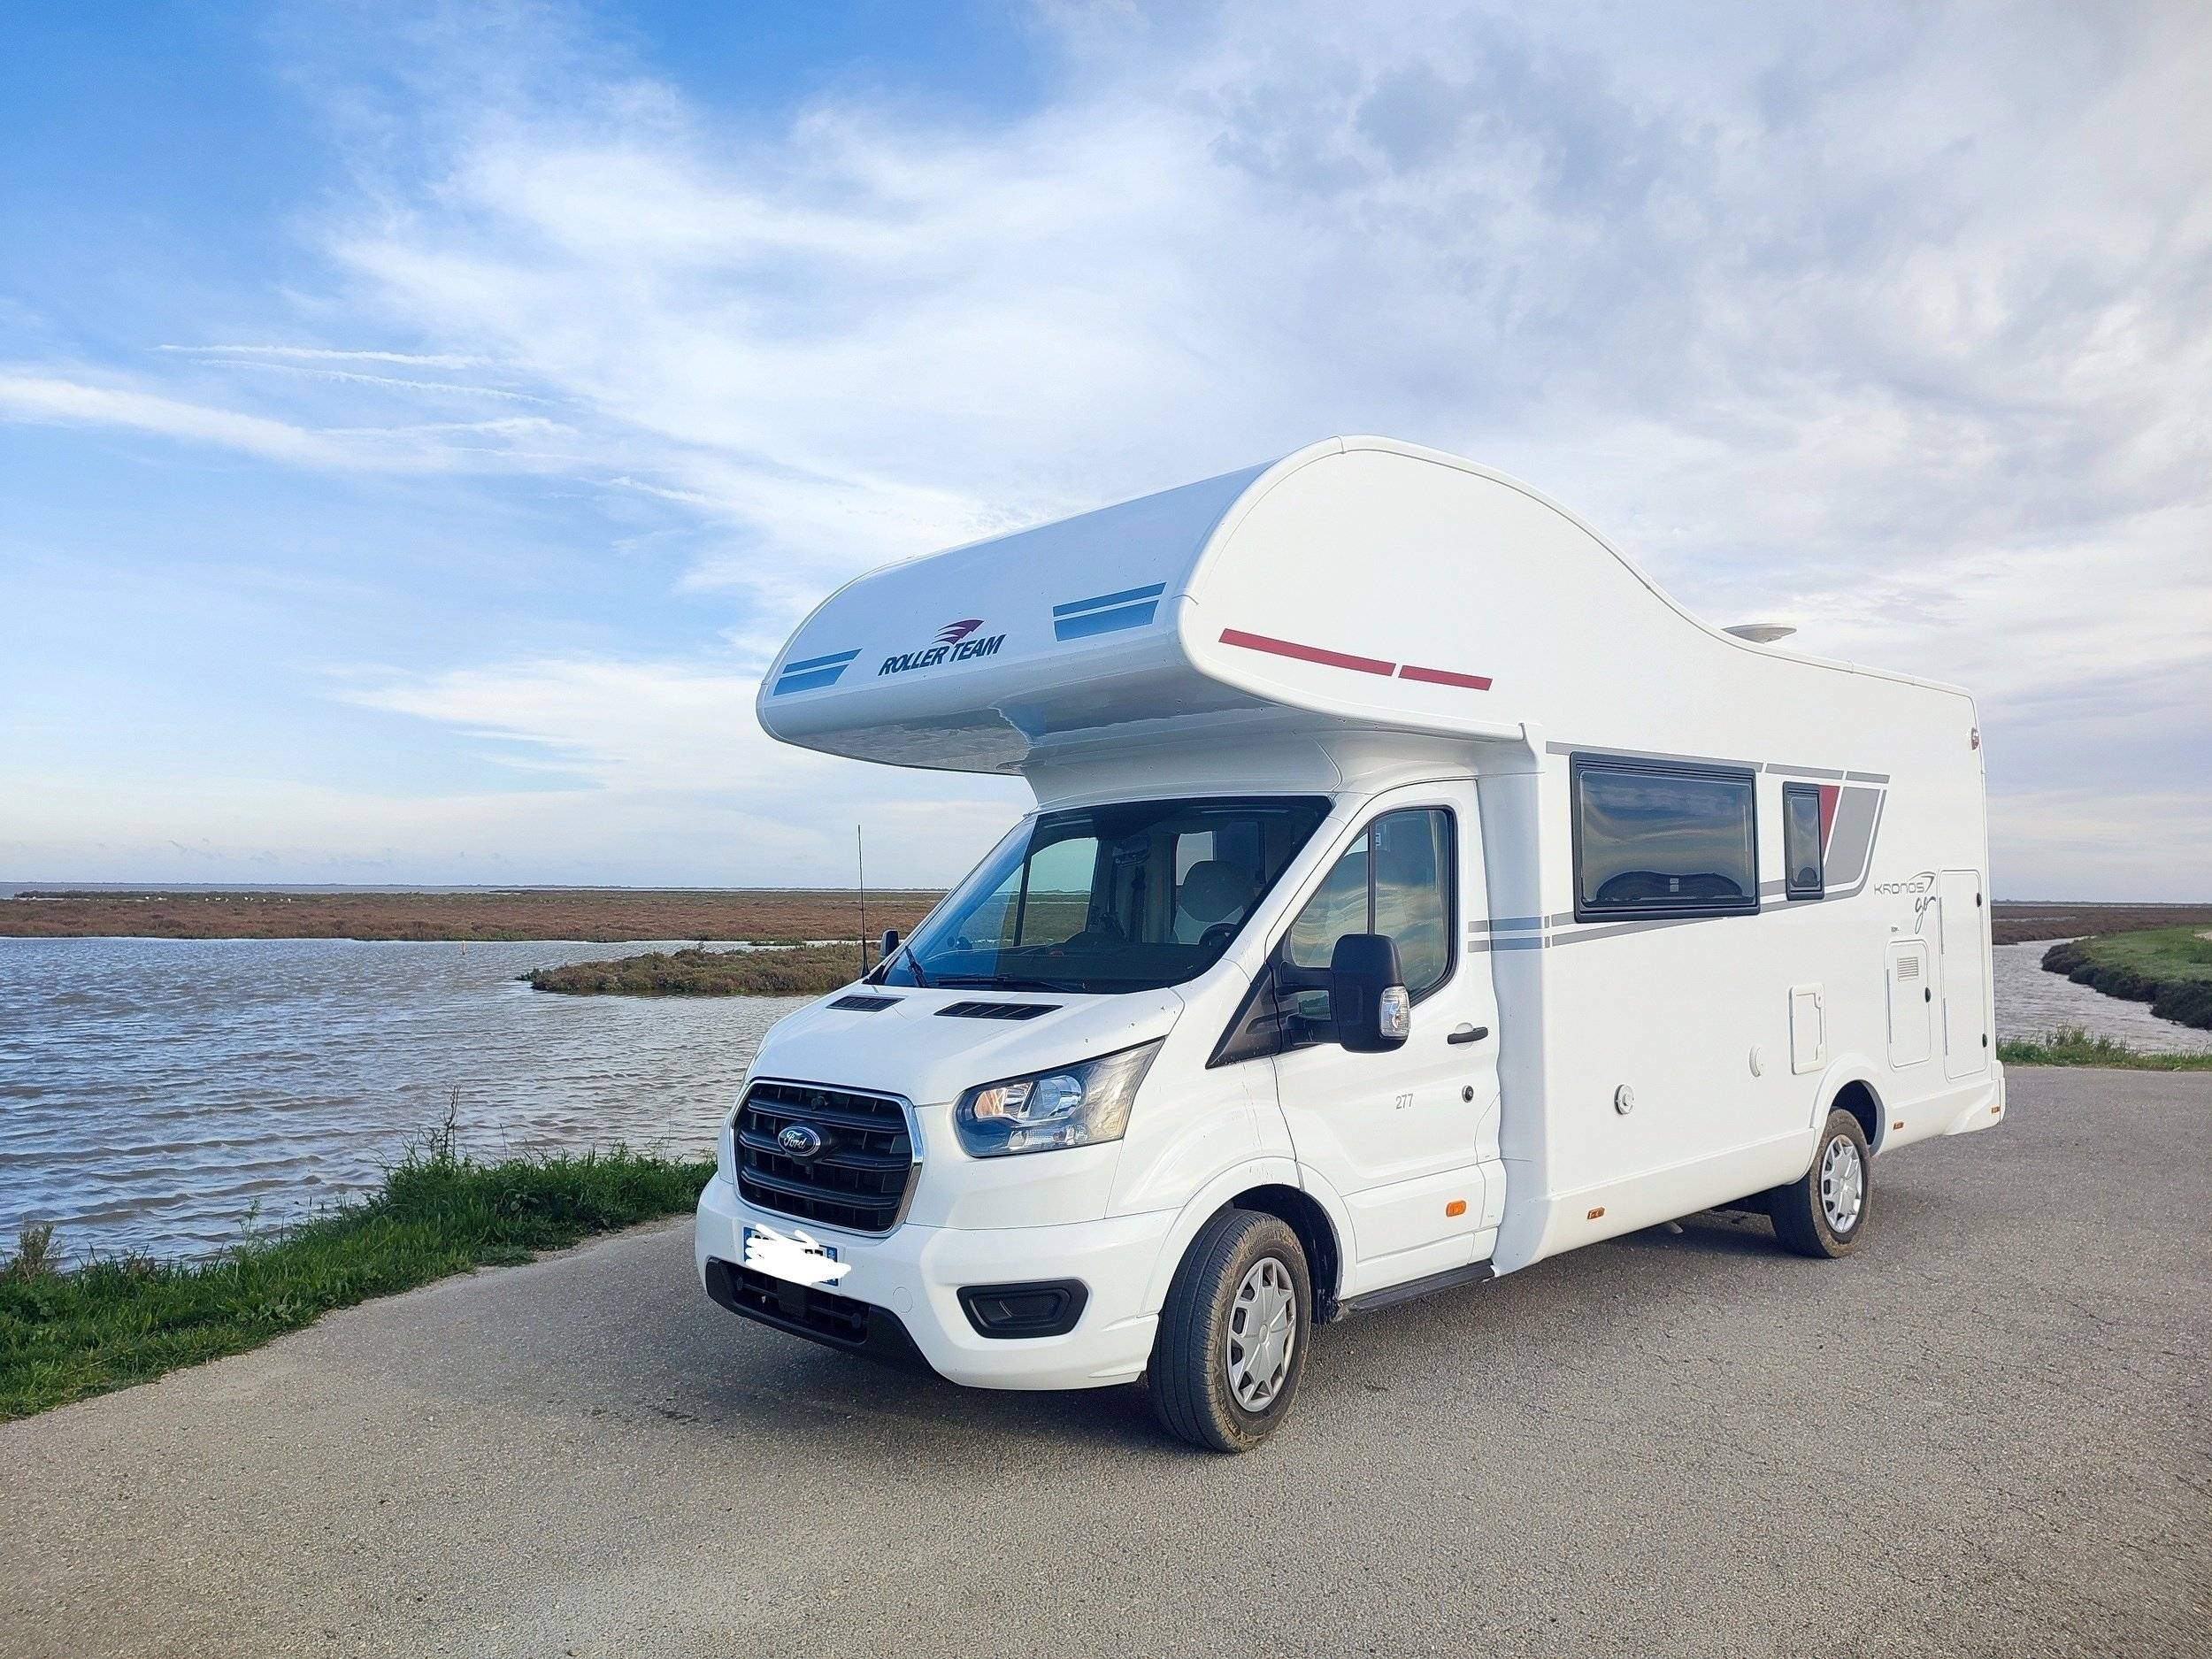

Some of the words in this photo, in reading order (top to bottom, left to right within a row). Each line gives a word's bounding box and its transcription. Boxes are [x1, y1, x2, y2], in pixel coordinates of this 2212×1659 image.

[877, 645, 950, 676] ROLLER
[949, 634, 1007, 663] TEAM
[1395, 1093, 1414, 1110] 277
[783, 1130, 808, 1149] Ford
